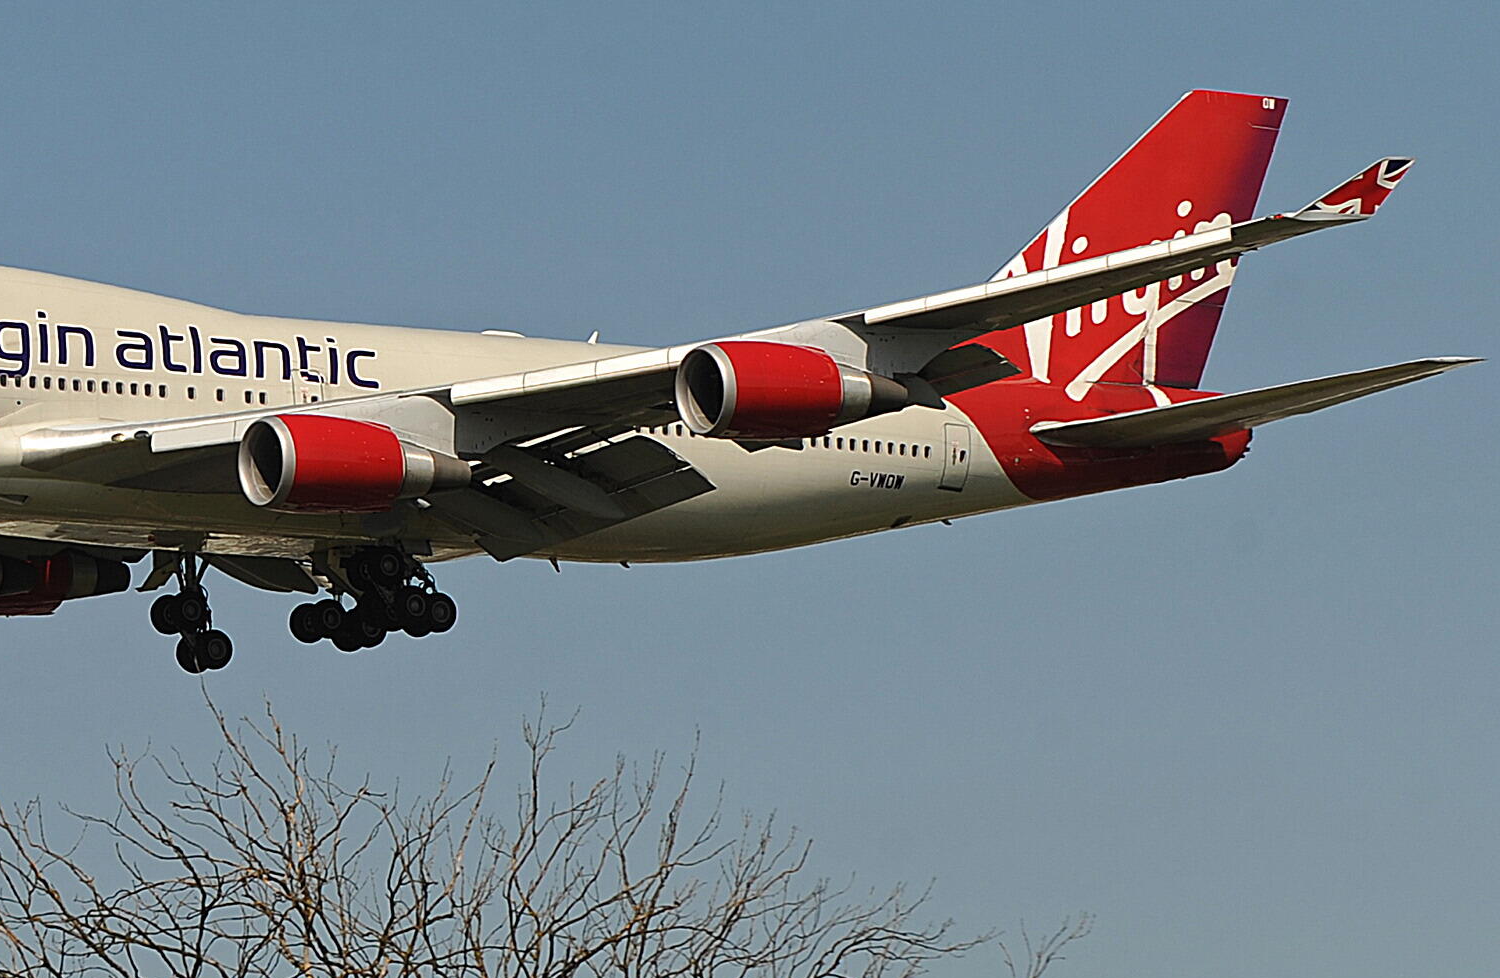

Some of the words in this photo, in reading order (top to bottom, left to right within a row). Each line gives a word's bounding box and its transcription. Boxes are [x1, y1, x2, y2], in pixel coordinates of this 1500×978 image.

[986, 199, 1239, 409] Vigin
[115, 325, 380, 390] atlantic
[850, 470, 905, 490] G-VWOW
